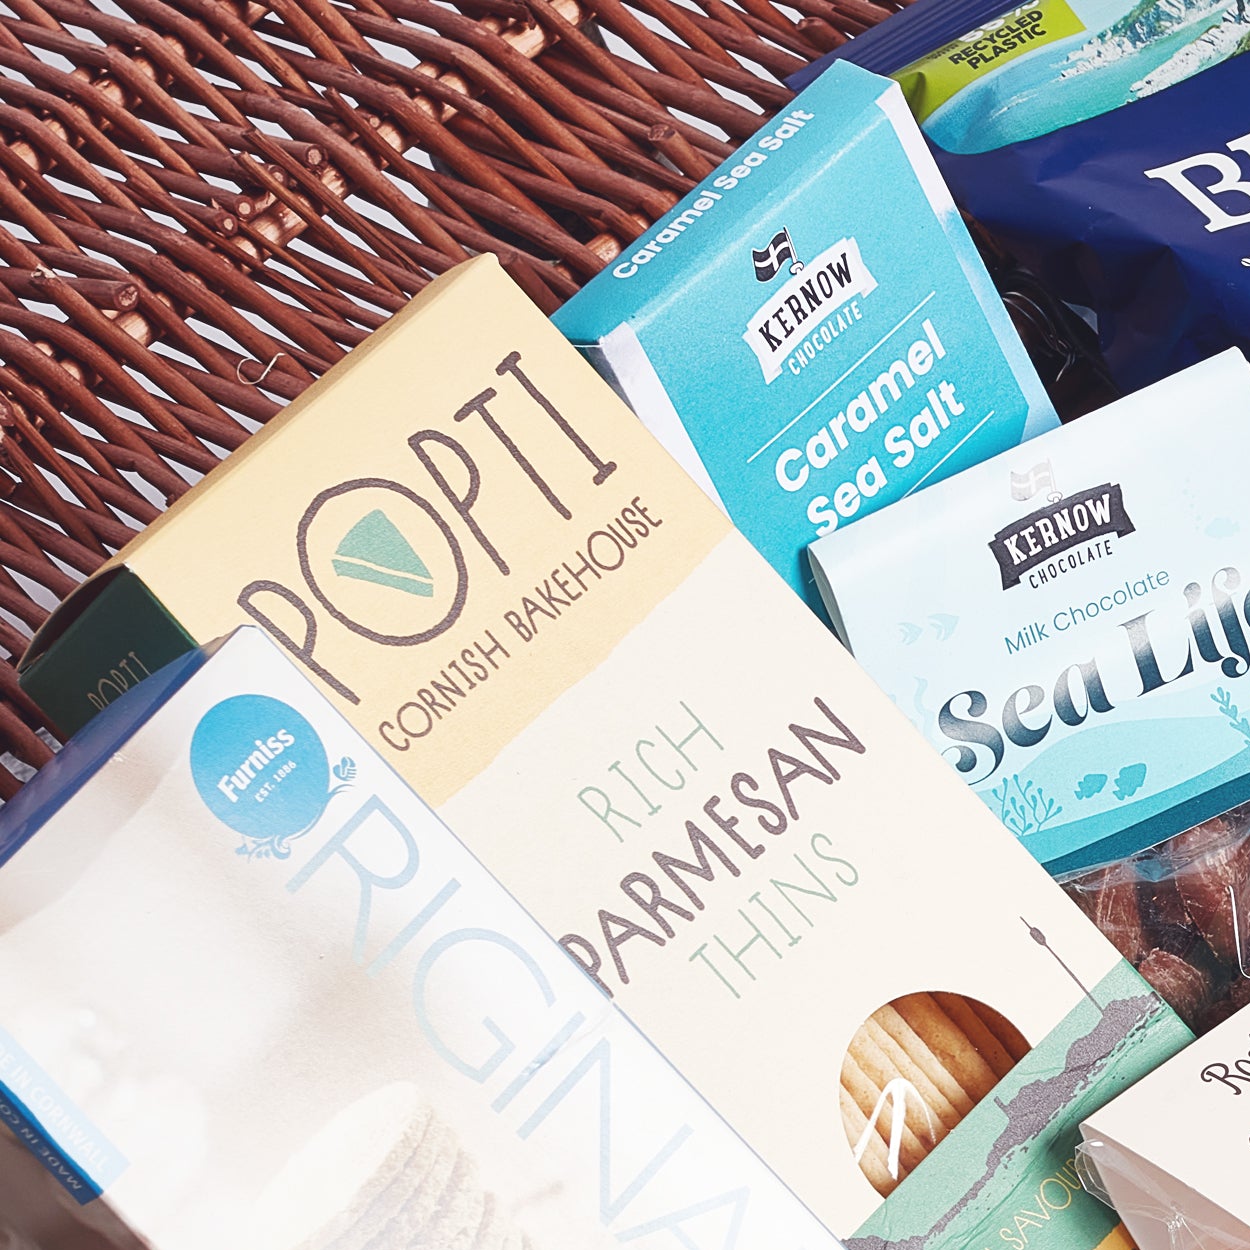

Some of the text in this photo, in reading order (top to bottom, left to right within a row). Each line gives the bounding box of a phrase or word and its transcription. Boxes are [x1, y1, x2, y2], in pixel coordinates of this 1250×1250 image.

[949, 10, 1043, 65] RECYCLED
[967, 23, 1047, 70] PLASTIC
[612, 107, 814, 281] Caramel Sea Salt
[758, 253, 853, 352] KERNOW
[787, 301, 862, 375] CHOCOLATE
[774, 320, 948, 492] Caramel
[807, 380, 966, 538] Sea Salt
[236, 351, 618, 706] POPTI
[1003, 494, 1115, 566] KERNOW
[1029, 539, 1113, 591] CHOCOLATE
[379, 497, 663, 753] CORNISH BAKEHOUSE
[1004, 568, 1170, 656] Milk Chocolate
[216, 728, 296, 803] Furniss
[577, 701, 724, 842] RICH
[935, 673, 1111, 785] Sea
[255, 760, 297, 802] EST. 1886
[557, 697, 866, 998] PARMESAN
[689, 833, 859, 999] THINS
[29, 1086, 112, 1171] CORNWALL
